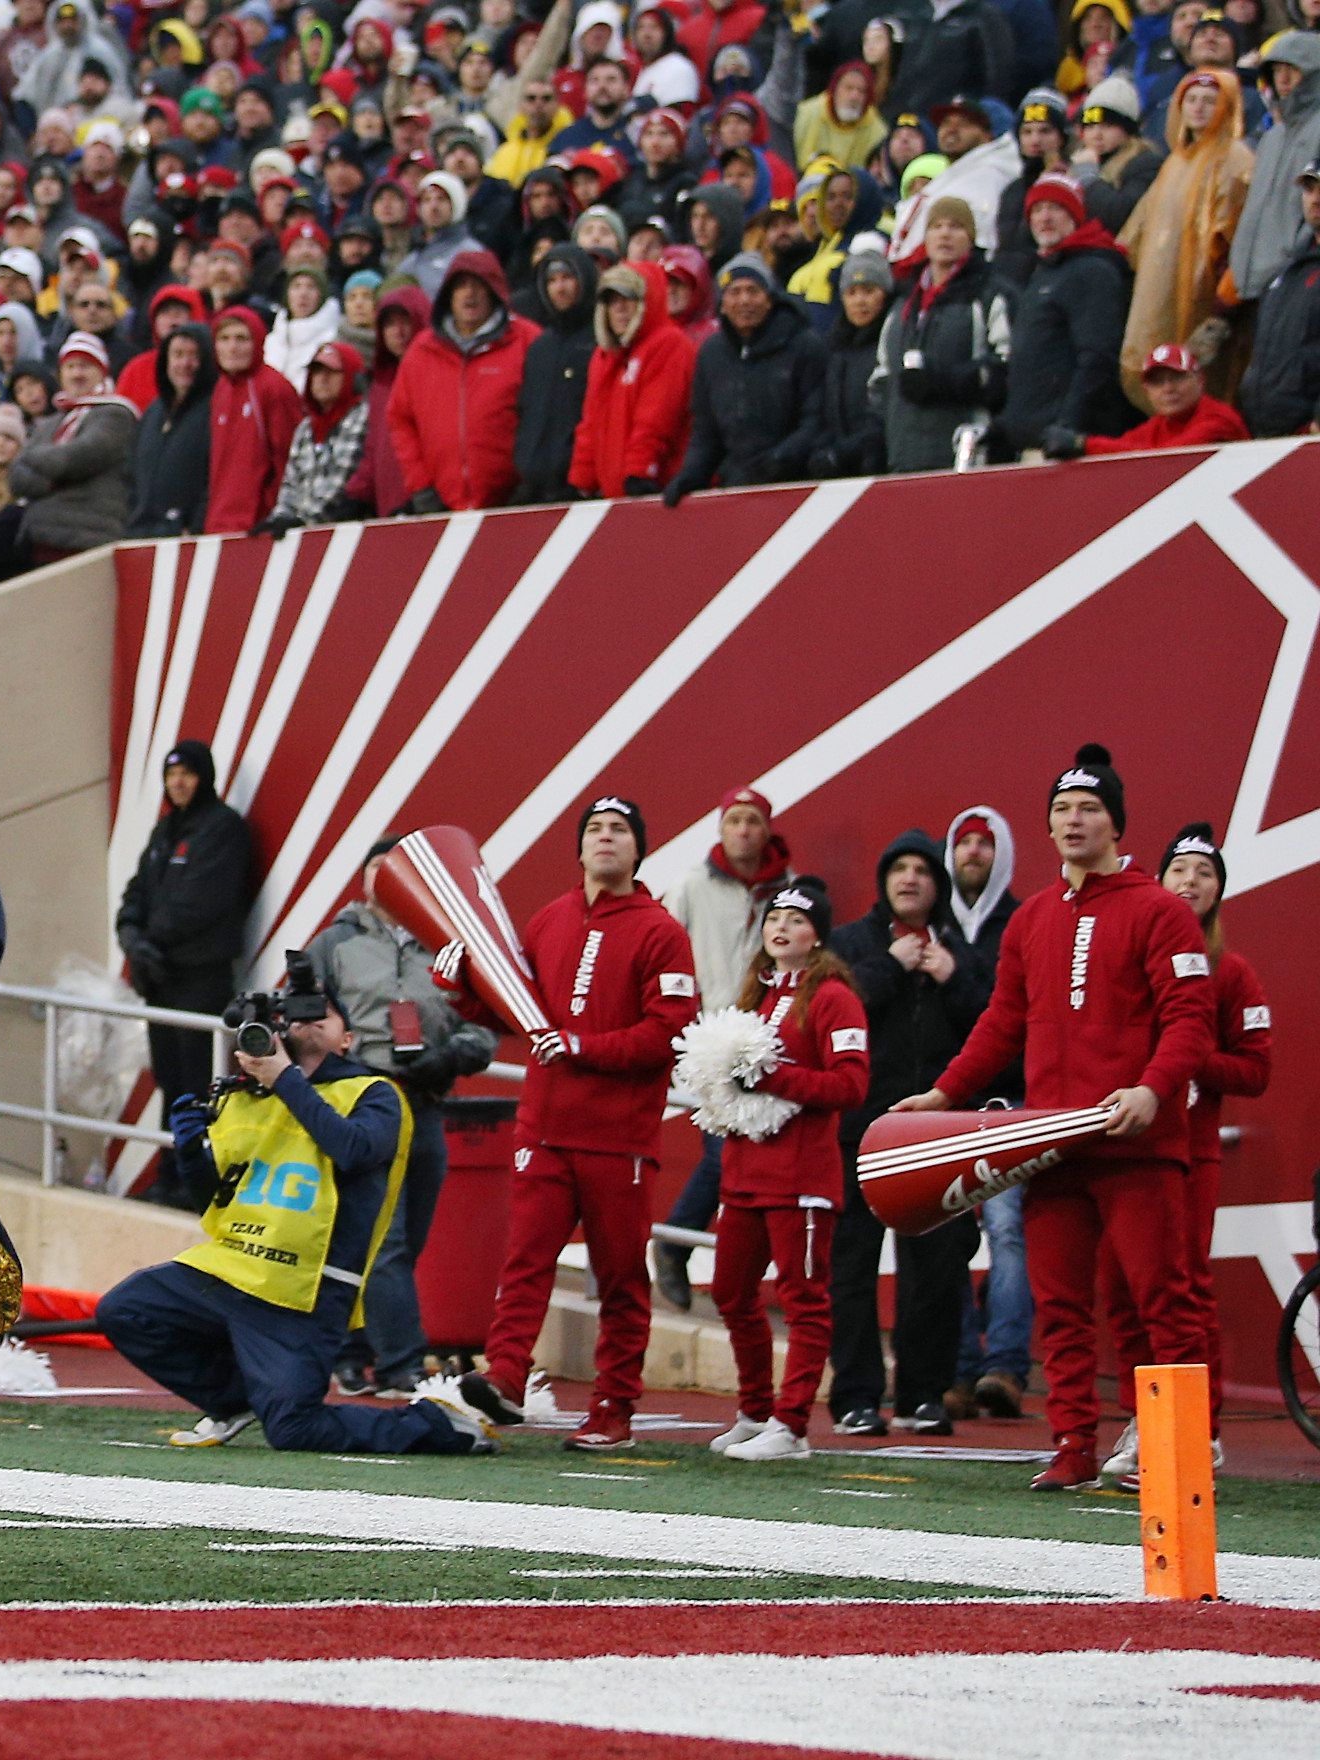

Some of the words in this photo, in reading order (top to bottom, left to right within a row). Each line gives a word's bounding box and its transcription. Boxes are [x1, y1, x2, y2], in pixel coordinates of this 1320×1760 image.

[572, 929, 605, 996] INDIANA
[1070, 916, 1097, 988] INDIANA
[941, 1148, 1063, 1212] Indiana
[229, 1222, 266, 1237] TEAM
